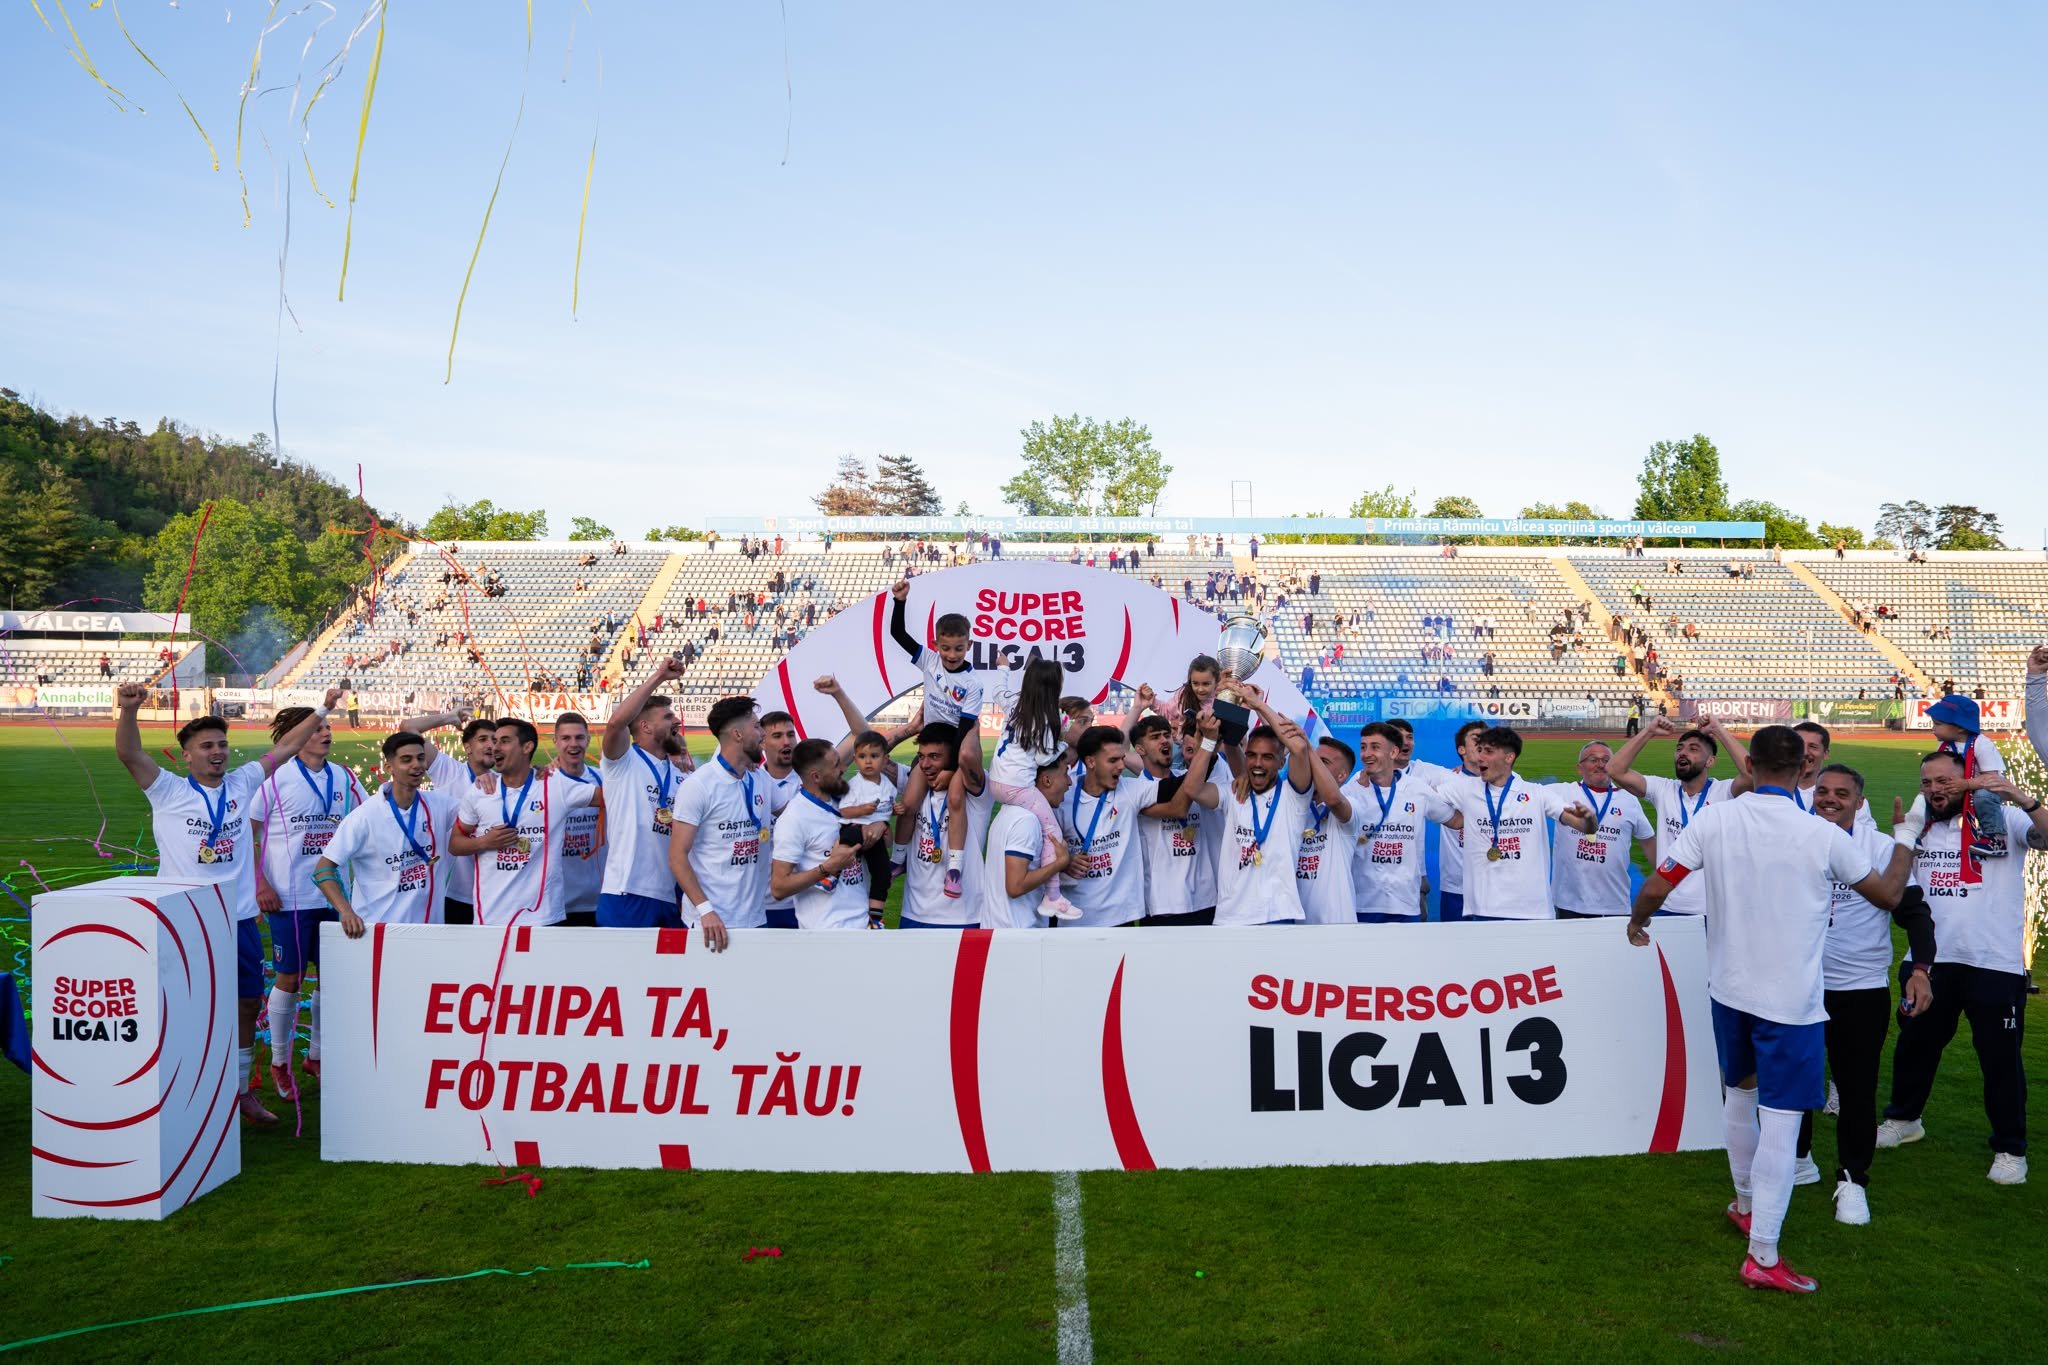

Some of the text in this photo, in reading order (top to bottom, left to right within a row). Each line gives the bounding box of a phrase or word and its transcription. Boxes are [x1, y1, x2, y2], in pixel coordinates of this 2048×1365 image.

[788, 517, 825, 531] Sport
[827, 517, 857, 530] Club
[861, 517, 928, 531] Municipal
[961, 518, 1003, 530] Vâlcea
[1015, 518, 1073, 530] Succesul
[1079, 518, 1100, 530] stă
[1103, 517, 1116, 530] în
[1119, 519, 1171, 532] puterea
[1384, 519, 1697, 536] Primăria Râmnicu Vâlcea sprijină sportul vâlcean
[976, 588, 1084, 616] SUPER
[973, 614, 1086, 641] SCORE
[1062, 642, 1085, 673] 3
[40, 690, 112, 704] Annabella
[694, 696, 718, 704] PIZZA
[674, 704, 707, 712] CHEERS
[1697, 700, 1775, 717] BIBORTENI
[304, 831, 334, 840] SUPER
[733, 838, 760, 849] SUPER
[1374, 840, 1403, 850] SUPER
[1578, 839, 1607, 849] SUPER
[301, 846, 323, 856] LIGA
[732, 848, 760, 857] SCORE
[1372, 848, 1403, 856] SCORE
[1514, 851, 1521, 860] 3
[1577, 845, 1607, 856] SCORE
[497, 854, 530, 862] SCORE
[1371, 855, 1402, 865] LIGA 3
[1576, 851, 1595, 862] LIGA
[401, 864, 426, 877] UPER
[1919, 861, 1942, 869] EDIȚIA
[400, 870, 427, 884] CORE
[1931, 870, 1961, 880] SUPE
[397, 882, 416, 893] IGA
[1930, 878, 1961, 888] SCOR
[1929, 887, 1968, 898] LIGA 3
[54, 976, 136, 997] SUPER
[1247, 964, 1564, 1021] SUPERSCORE
[52, 996, 138, 1018] SCORE
[424, 983, 729, 1051] ECHIPA TA,
[53, 1017, 138, 1042] LIGA 3
[1249, 1016, 1568, 1112] LIGA 3
[424, 1051, 862, 1117] FOTBALUL TĂU!
